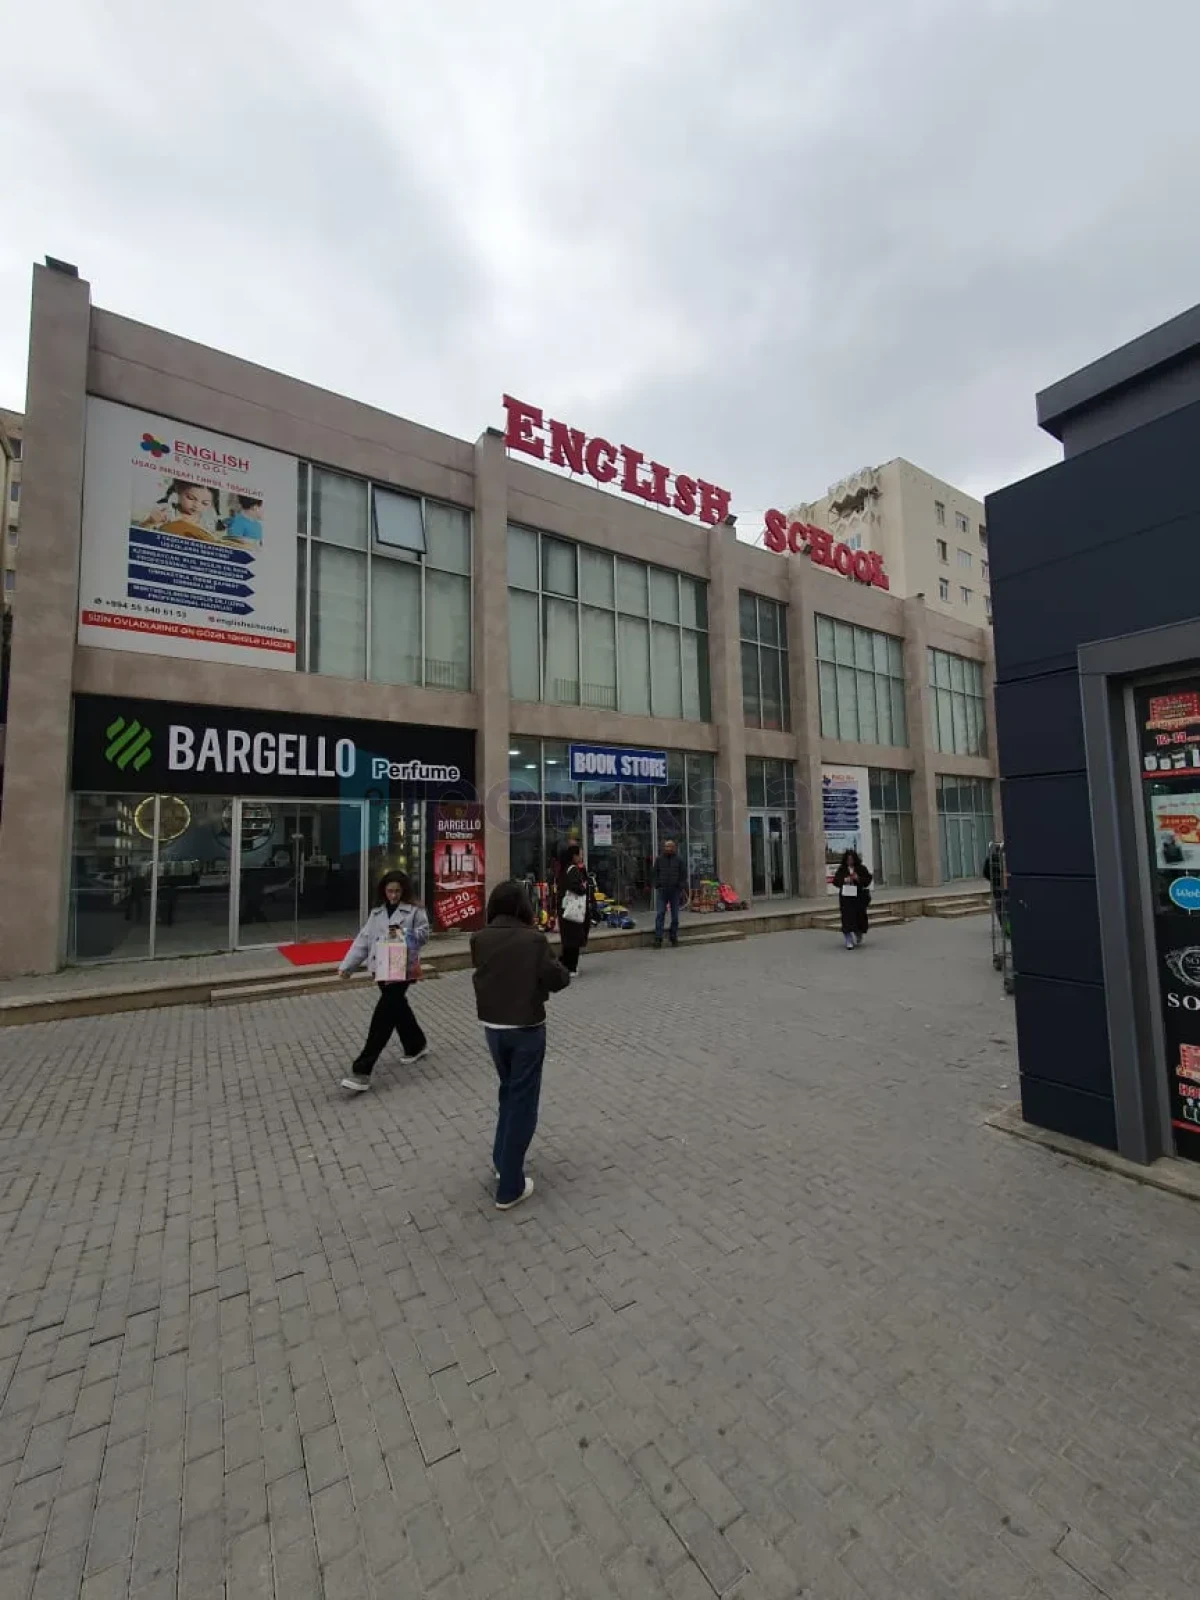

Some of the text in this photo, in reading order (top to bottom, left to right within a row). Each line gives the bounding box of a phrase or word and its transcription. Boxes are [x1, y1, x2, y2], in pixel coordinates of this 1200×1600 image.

[174, 440, 250, 472] ENGLISH
[174, 455, 228, 476] SCHOOL
[503, 394, 889, 590] ENGLISH SCHOOL
[168, 724, 461, 782] BARGELLO Perfume
[574, 752, 666, 779] BOOK STORE
[438, 819, 482, 831] BARGELLO
